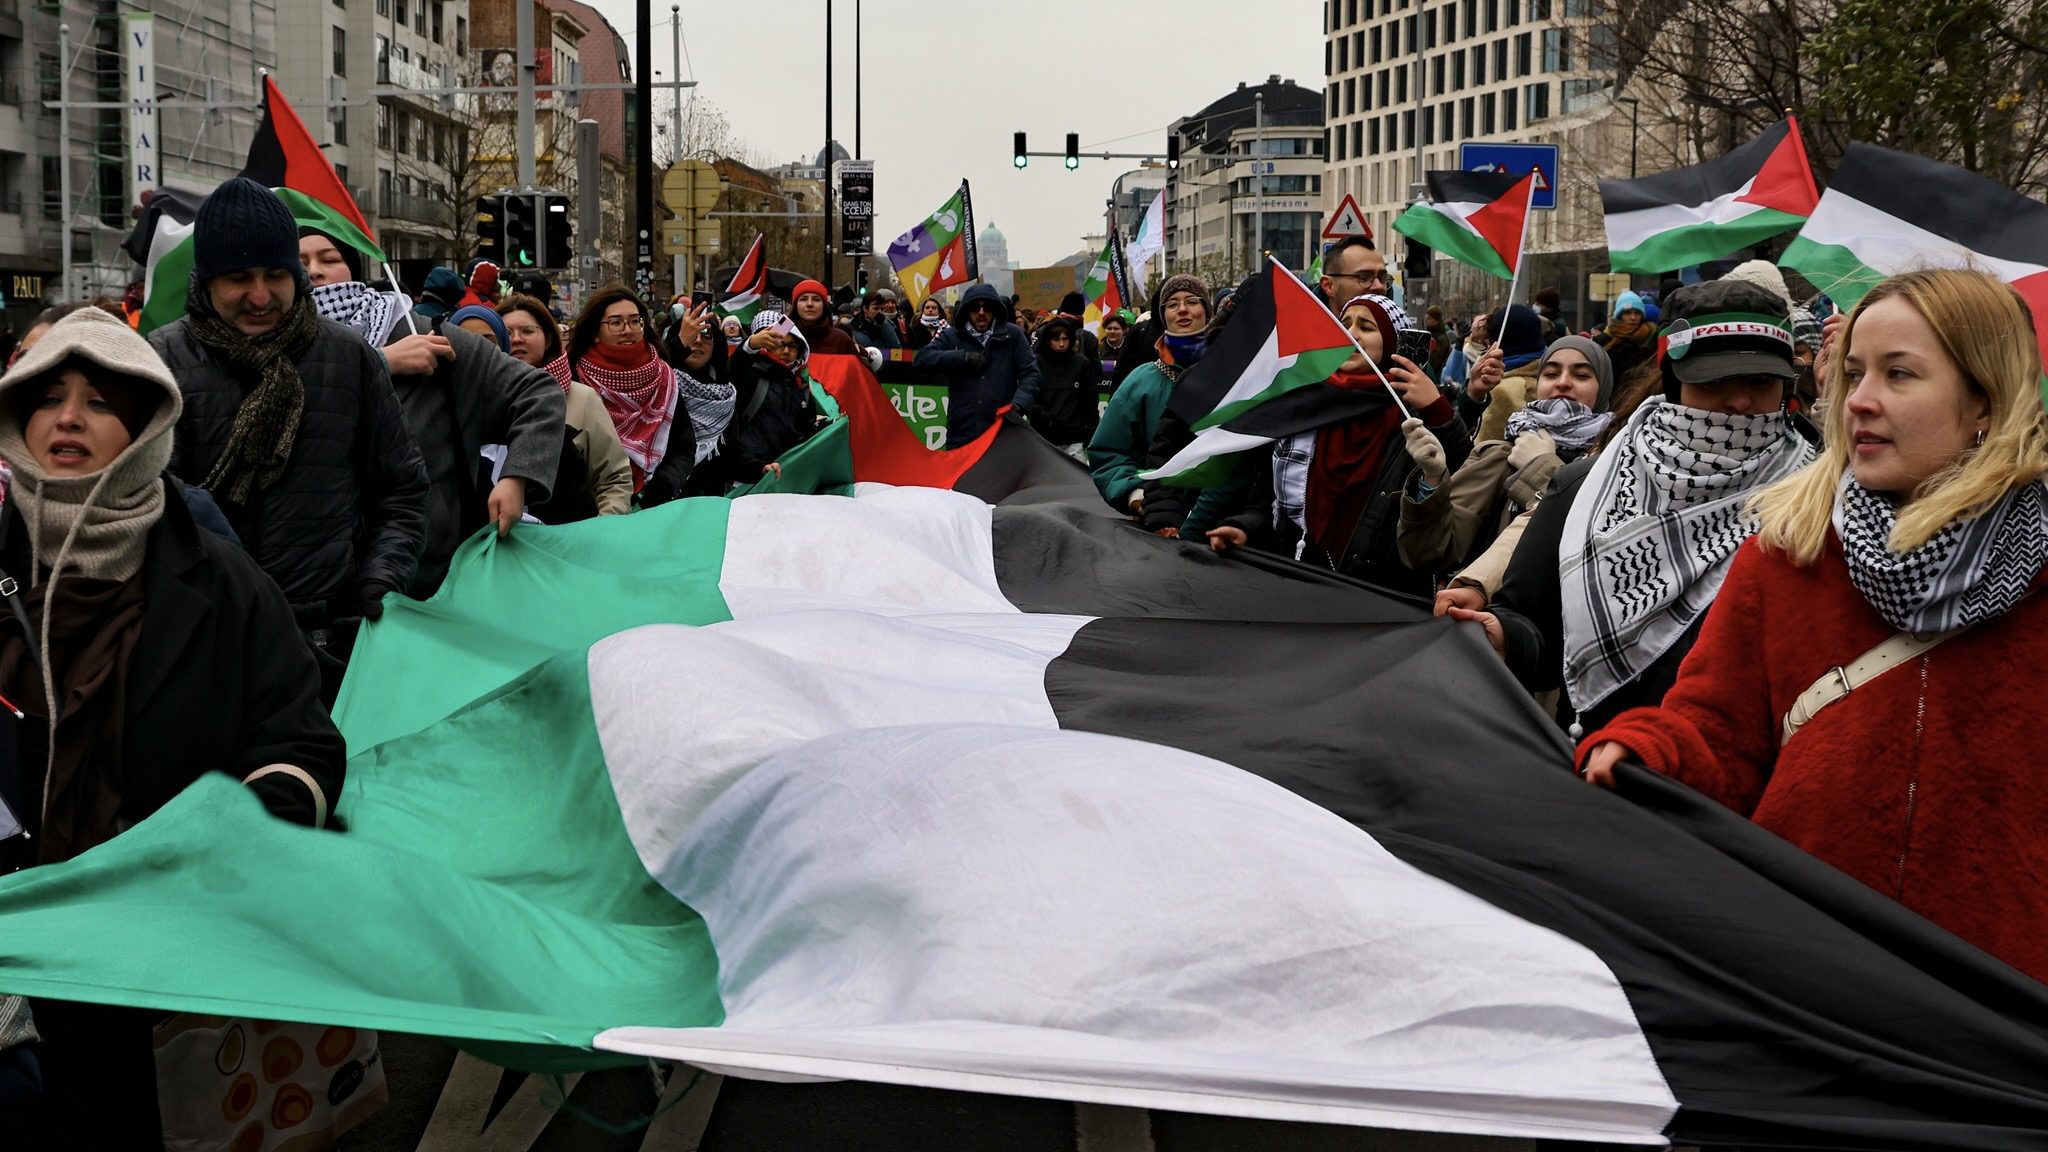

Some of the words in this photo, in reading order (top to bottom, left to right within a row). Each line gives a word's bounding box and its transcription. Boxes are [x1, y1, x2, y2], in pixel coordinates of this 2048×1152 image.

[133, 32, 153, 182] VIMAR
[1272, 200, 1309, 208] Erasme
[843, 207, 872, 215] CŒUR
